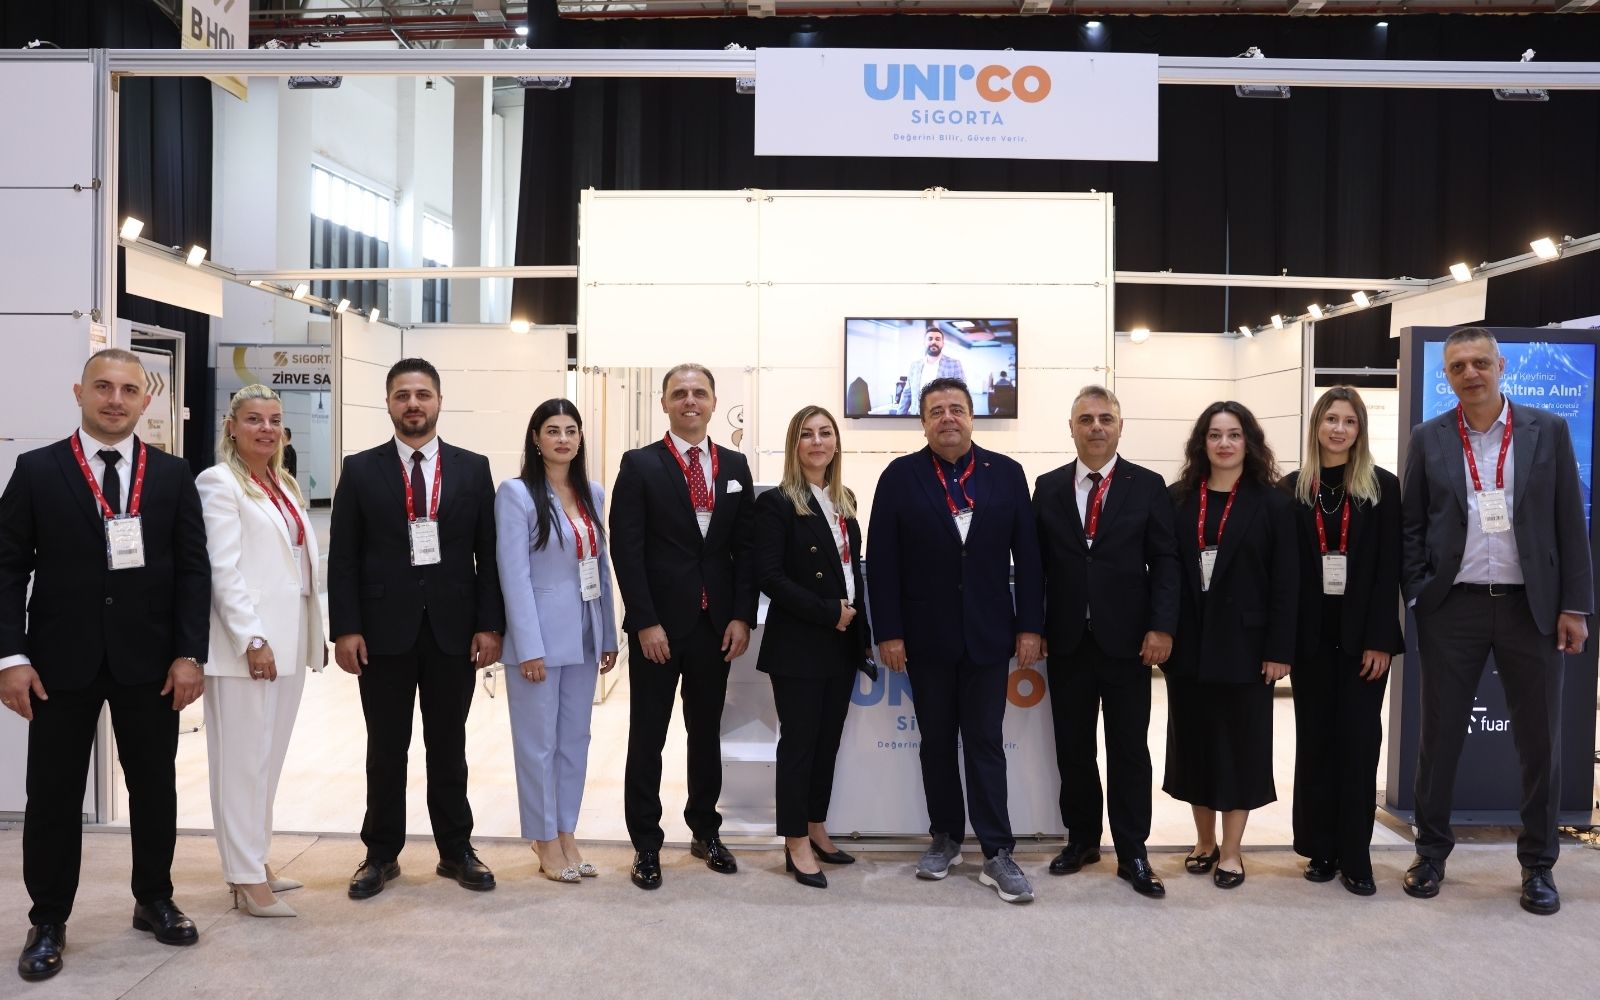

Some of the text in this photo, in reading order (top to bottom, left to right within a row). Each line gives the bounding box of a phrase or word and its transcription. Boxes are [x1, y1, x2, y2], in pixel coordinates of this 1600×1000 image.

[191, 6, 203, 42] B
[967, 134, 997, 142] Güven
[272, 370, 332, 385] ZİRVE SA
[1519, 372, 1557, 382] Keyfinizi
[1502, 383, 1582, 397] Altına Alın!
[1480, 715, 1511, 732] fuar
[877, 740, 921, 750] Değerin
